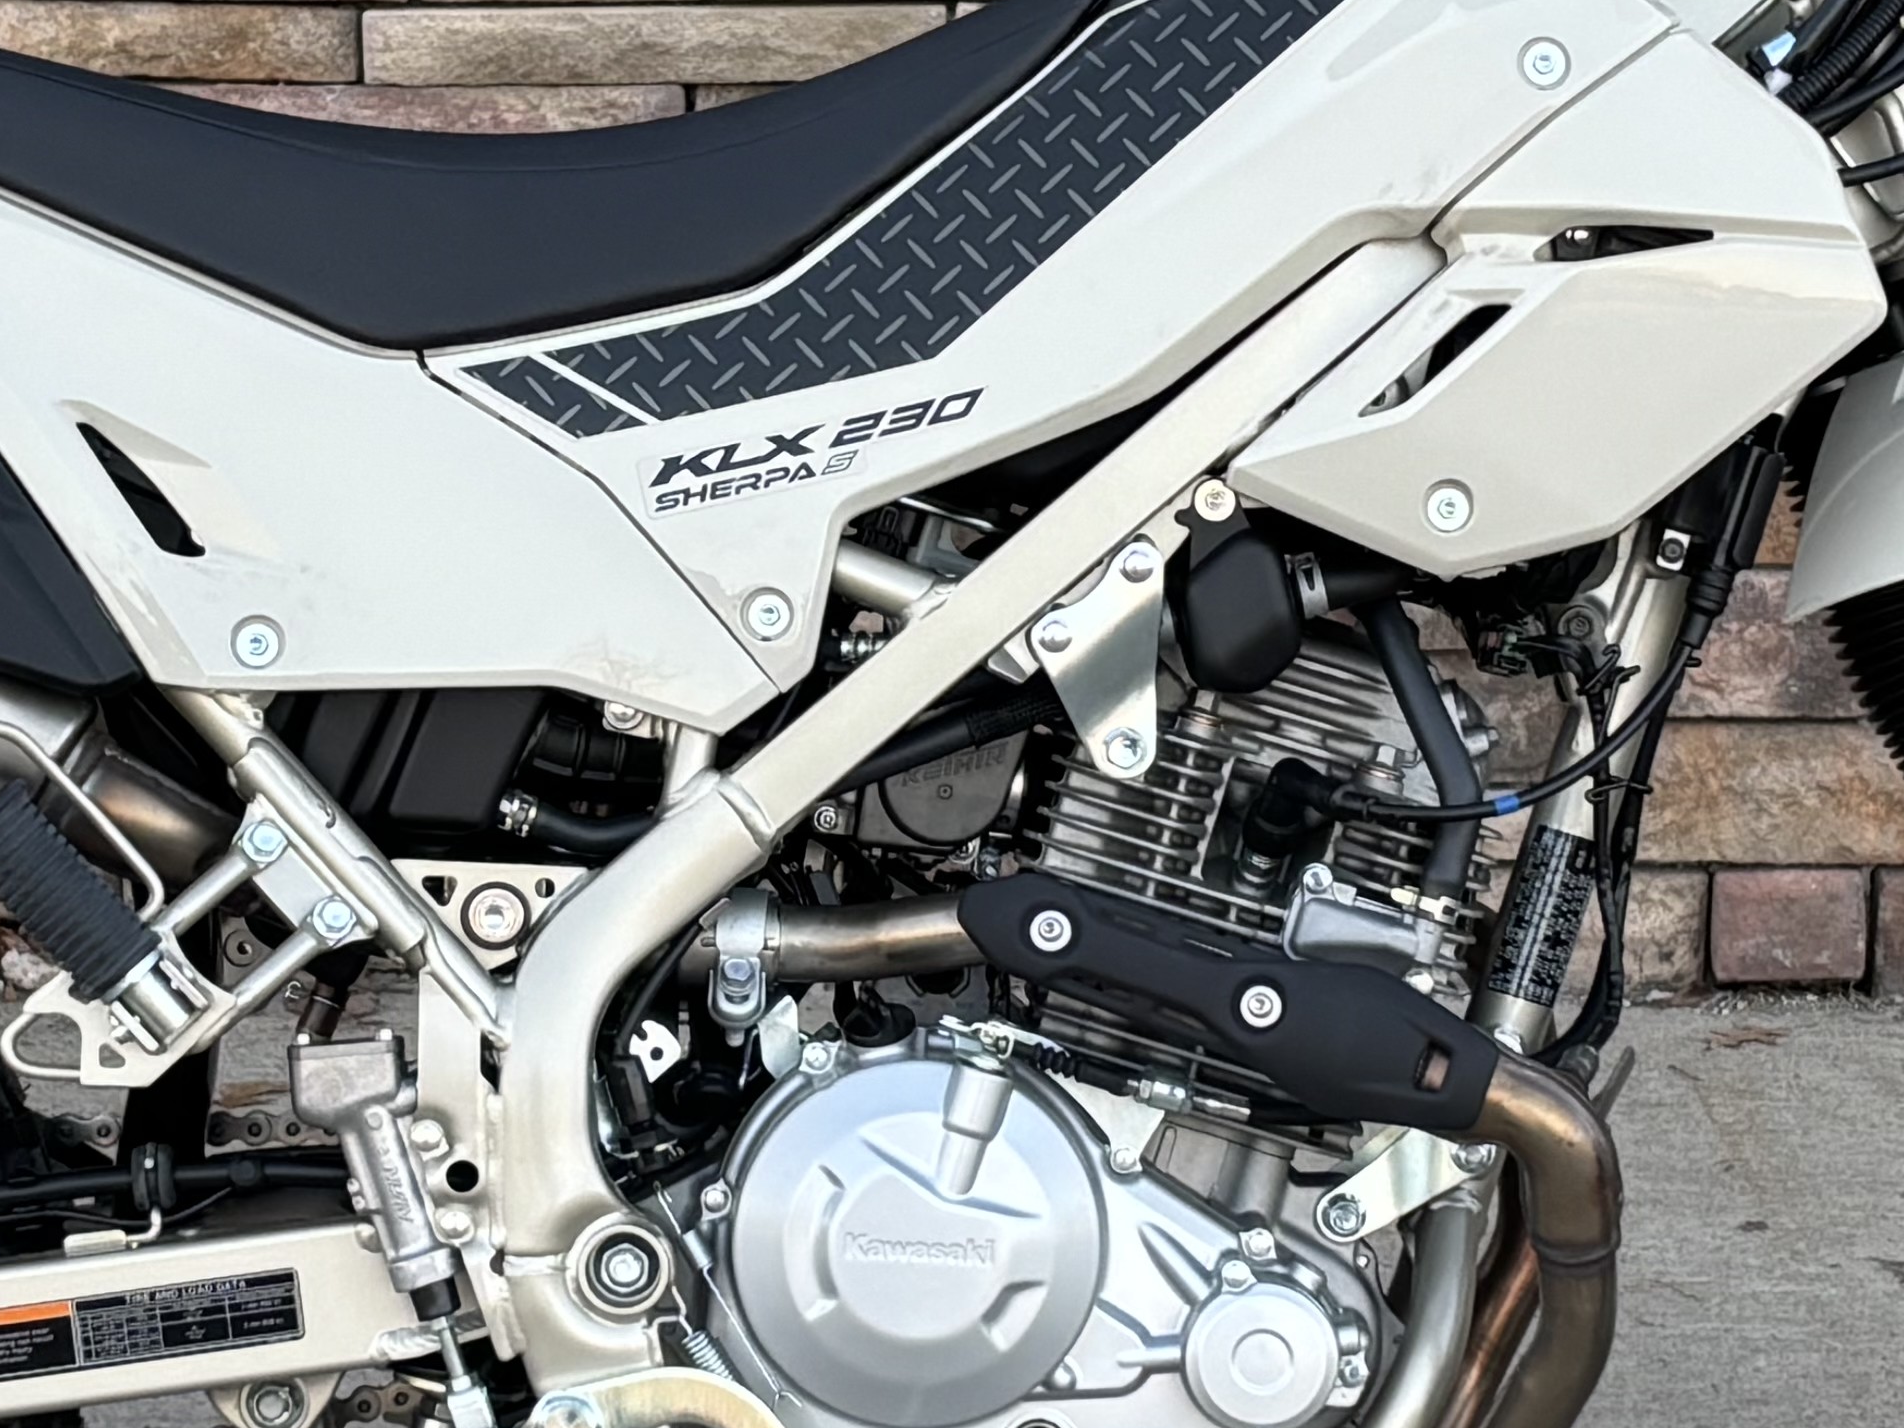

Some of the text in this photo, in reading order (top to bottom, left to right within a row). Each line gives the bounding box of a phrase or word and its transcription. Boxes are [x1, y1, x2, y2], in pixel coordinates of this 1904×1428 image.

[647, 384, 988, 489] KLX 230
[653, 461, 818, 514] SHERPA
[842, 1231, 997, 1267] Kawasaki
